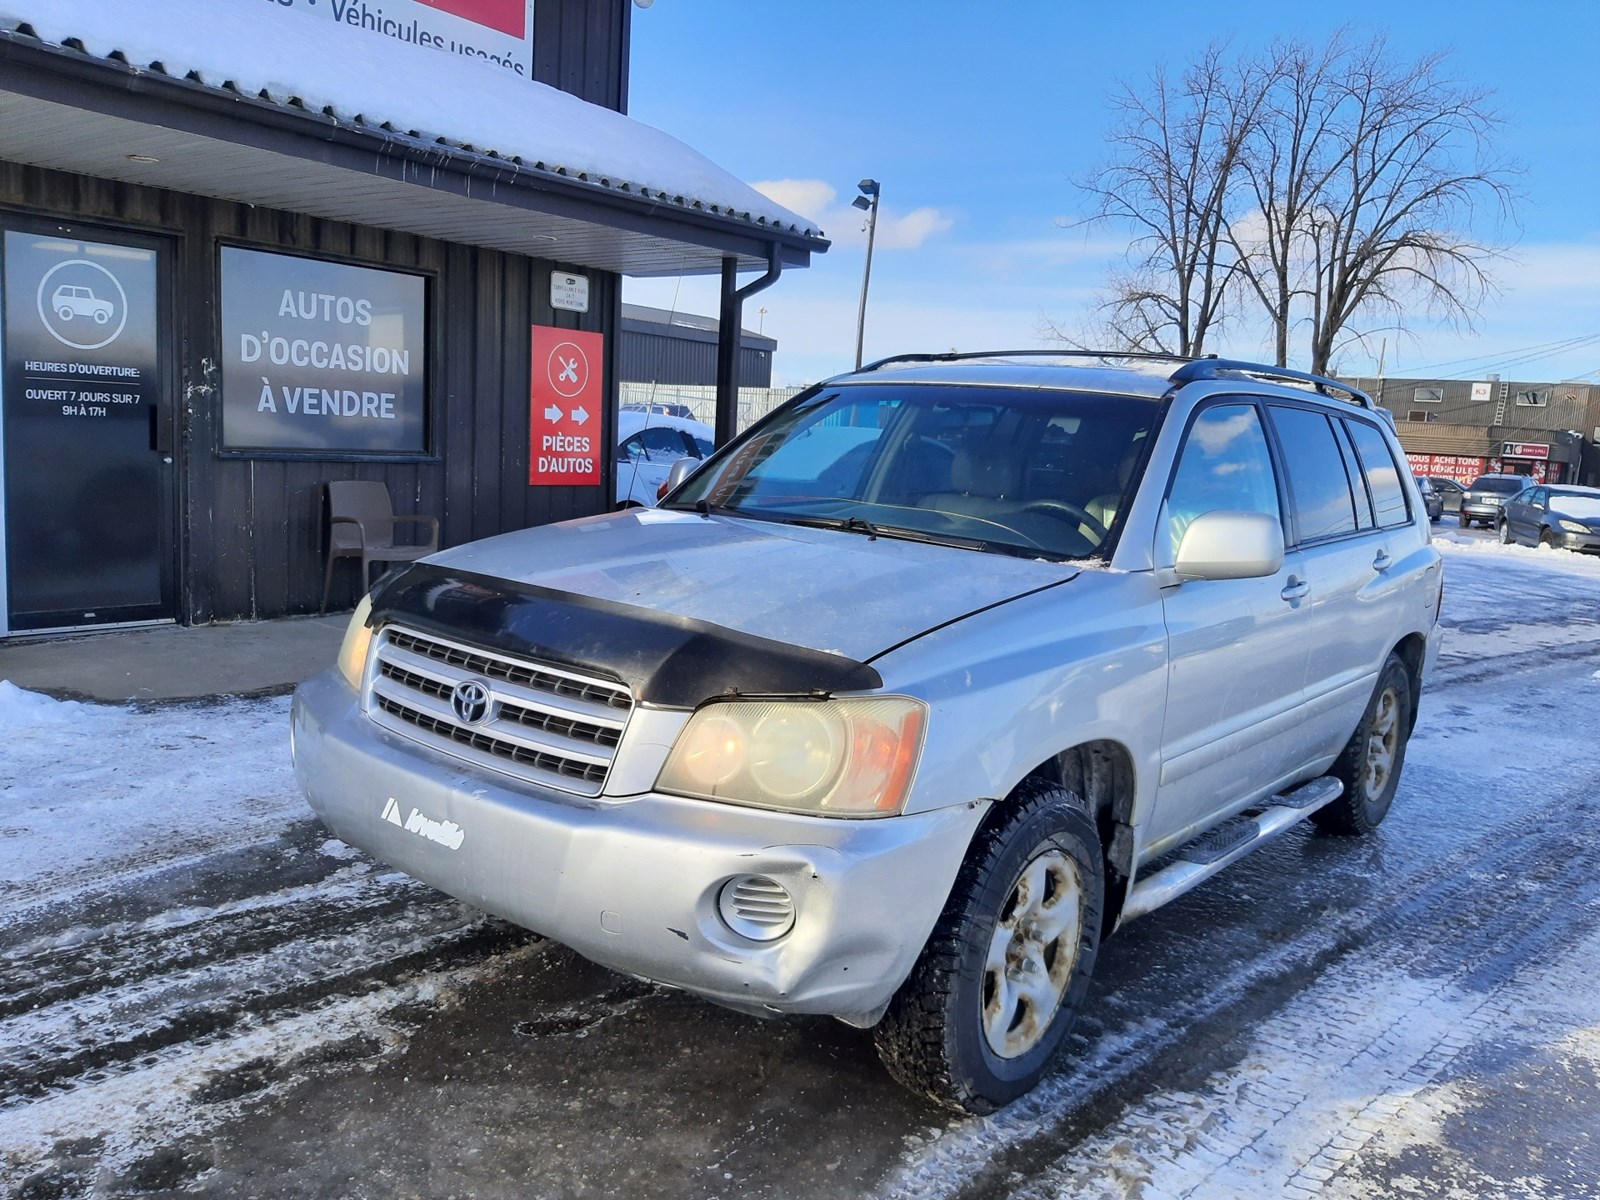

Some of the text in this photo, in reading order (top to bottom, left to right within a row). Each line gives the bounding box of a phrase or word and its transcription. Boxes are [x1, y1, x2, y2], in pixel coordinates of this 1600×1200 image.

[331, 0, 445, 48] Véhicules
[278, 289, 372, 326] AUTOS
[240, 330, 409, 375] D'OCCASION
[25, 361, 140, 377] HEURES D'OUVERTURE:
[25, 389, 140, 404] OUVERT 7 JOURS SUR 7
[257, 376, 396, 419] À VENDRE
[62, 404, 106, 417] 9H À 17H
[543, 431, 590, 452] PIÈCES
[538, 456, 593, 474] D'AUTOS
[1406, 454, 1430, 463] NOUS
[1410, 463, 1428, 472] VOS
[1430, 463, 1479, 476] VÉHICULES
